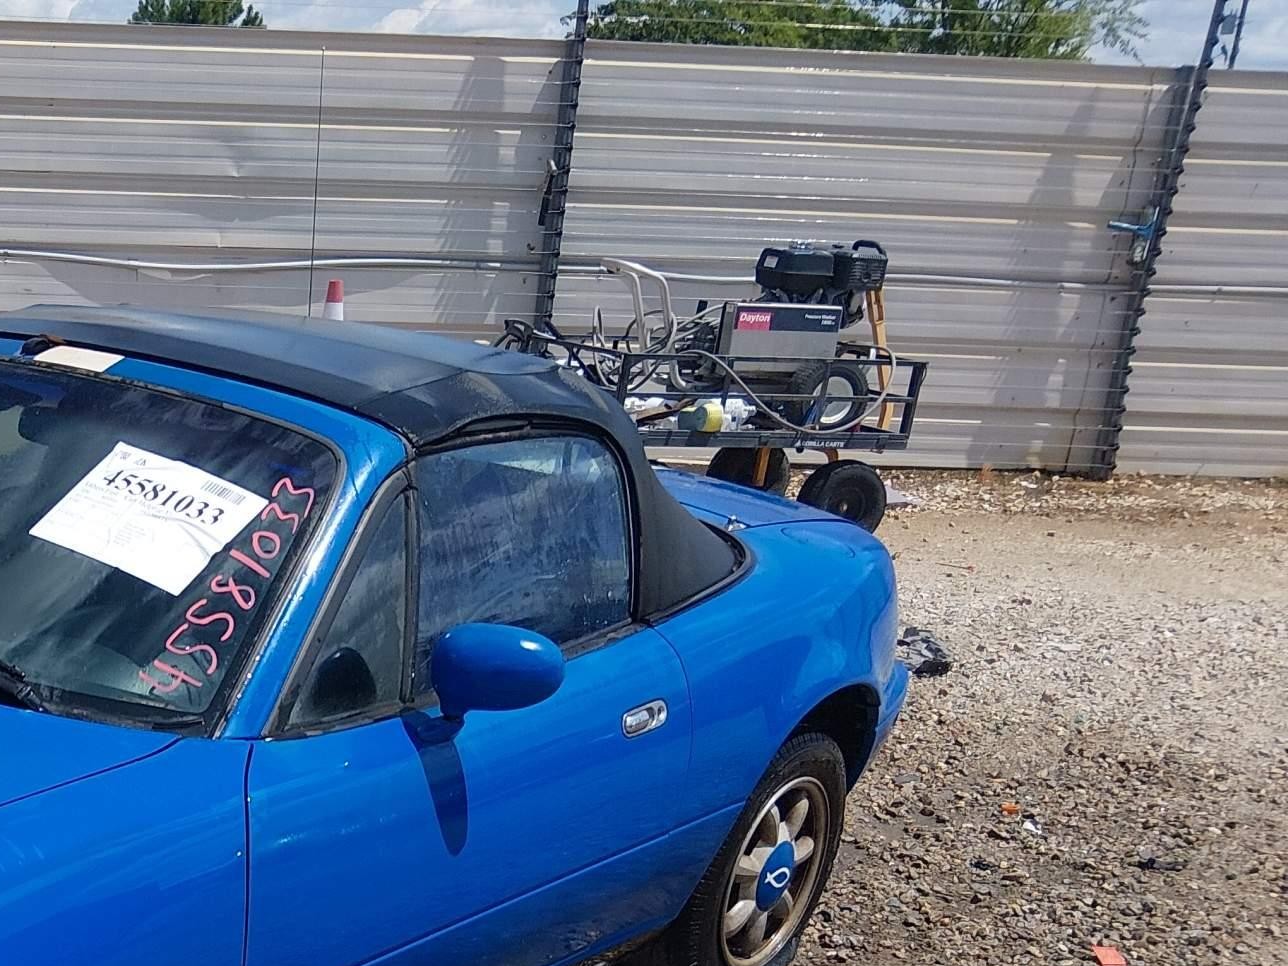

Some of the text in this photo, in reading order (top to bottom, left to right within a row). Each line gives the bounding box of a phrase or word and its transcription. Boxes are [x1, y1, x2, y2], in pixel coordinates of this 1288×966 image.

[739, 312, 771, 324] Dayton
[103, 470, 225, 526] 45581033
[139, 477, 315, 693] 45581033
